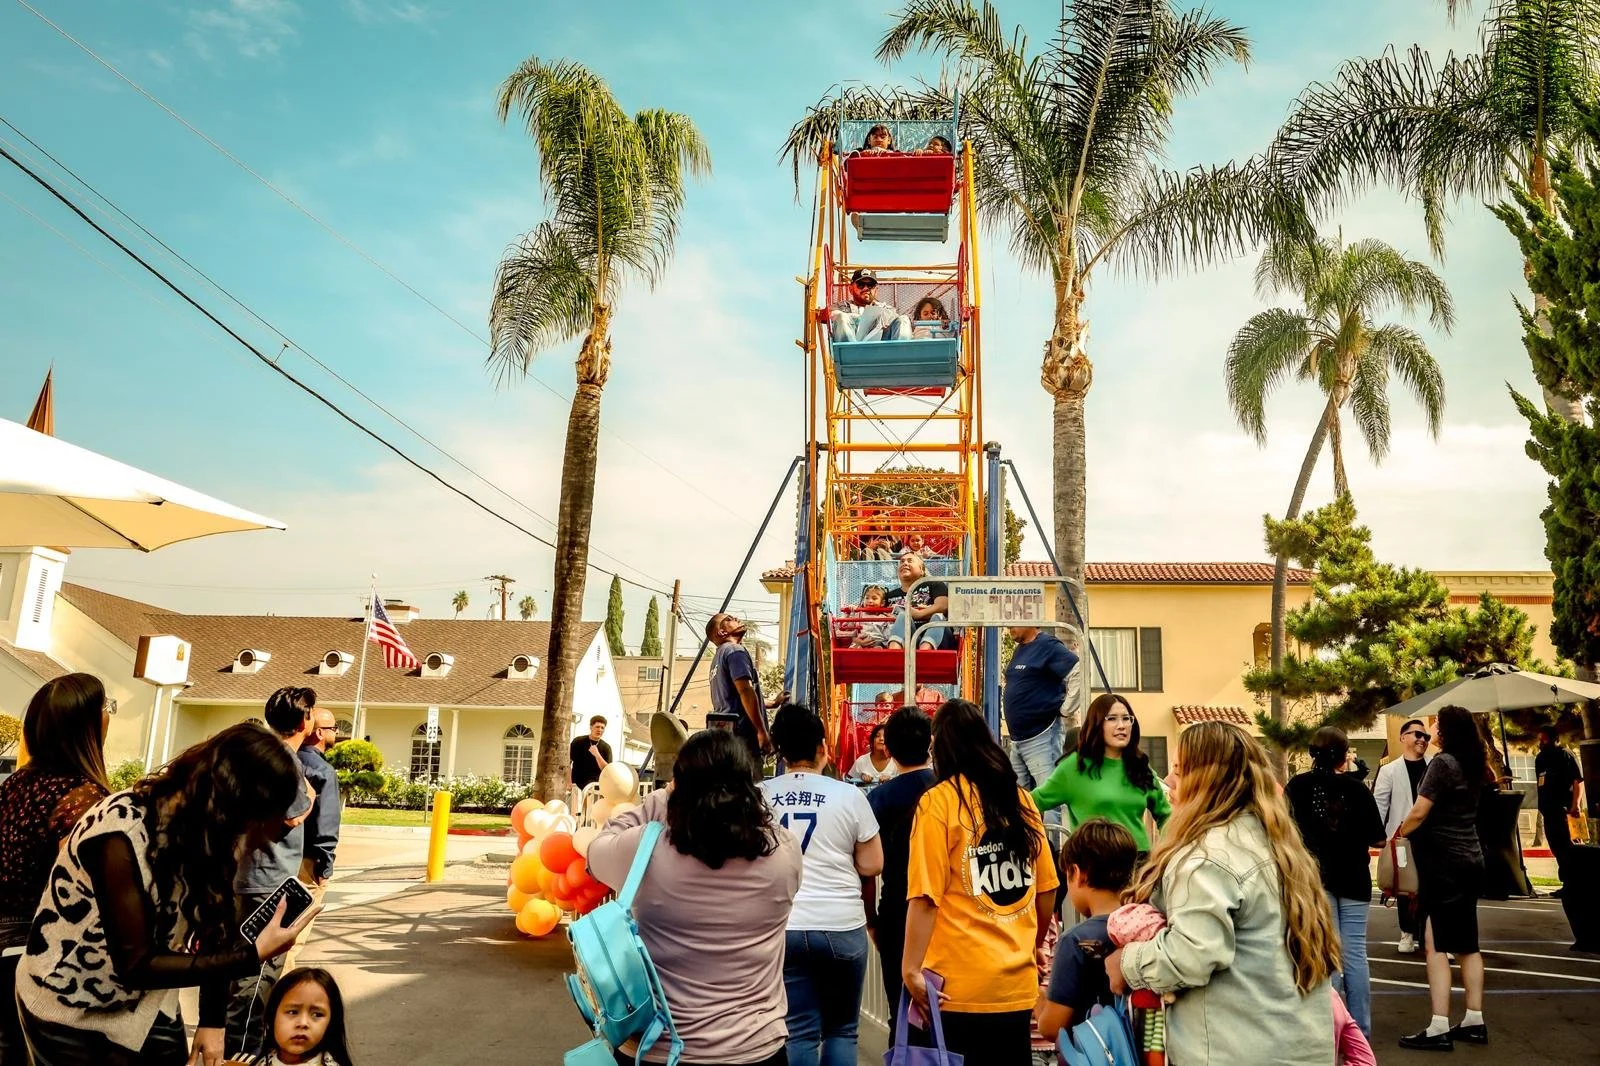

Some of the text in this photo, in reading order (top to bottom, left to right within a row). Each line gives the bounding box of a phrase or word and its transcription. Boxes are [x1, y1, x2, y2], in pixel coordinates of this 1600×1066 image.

[955, 587, 1042, 595] Funtime Amusements
[988, 595, 1043, 620] TICKET
[428, 726, 437, 739] 25
[771, 791, 826, 808] 大谷翔平
[969, 850, 1035, 896] kids
